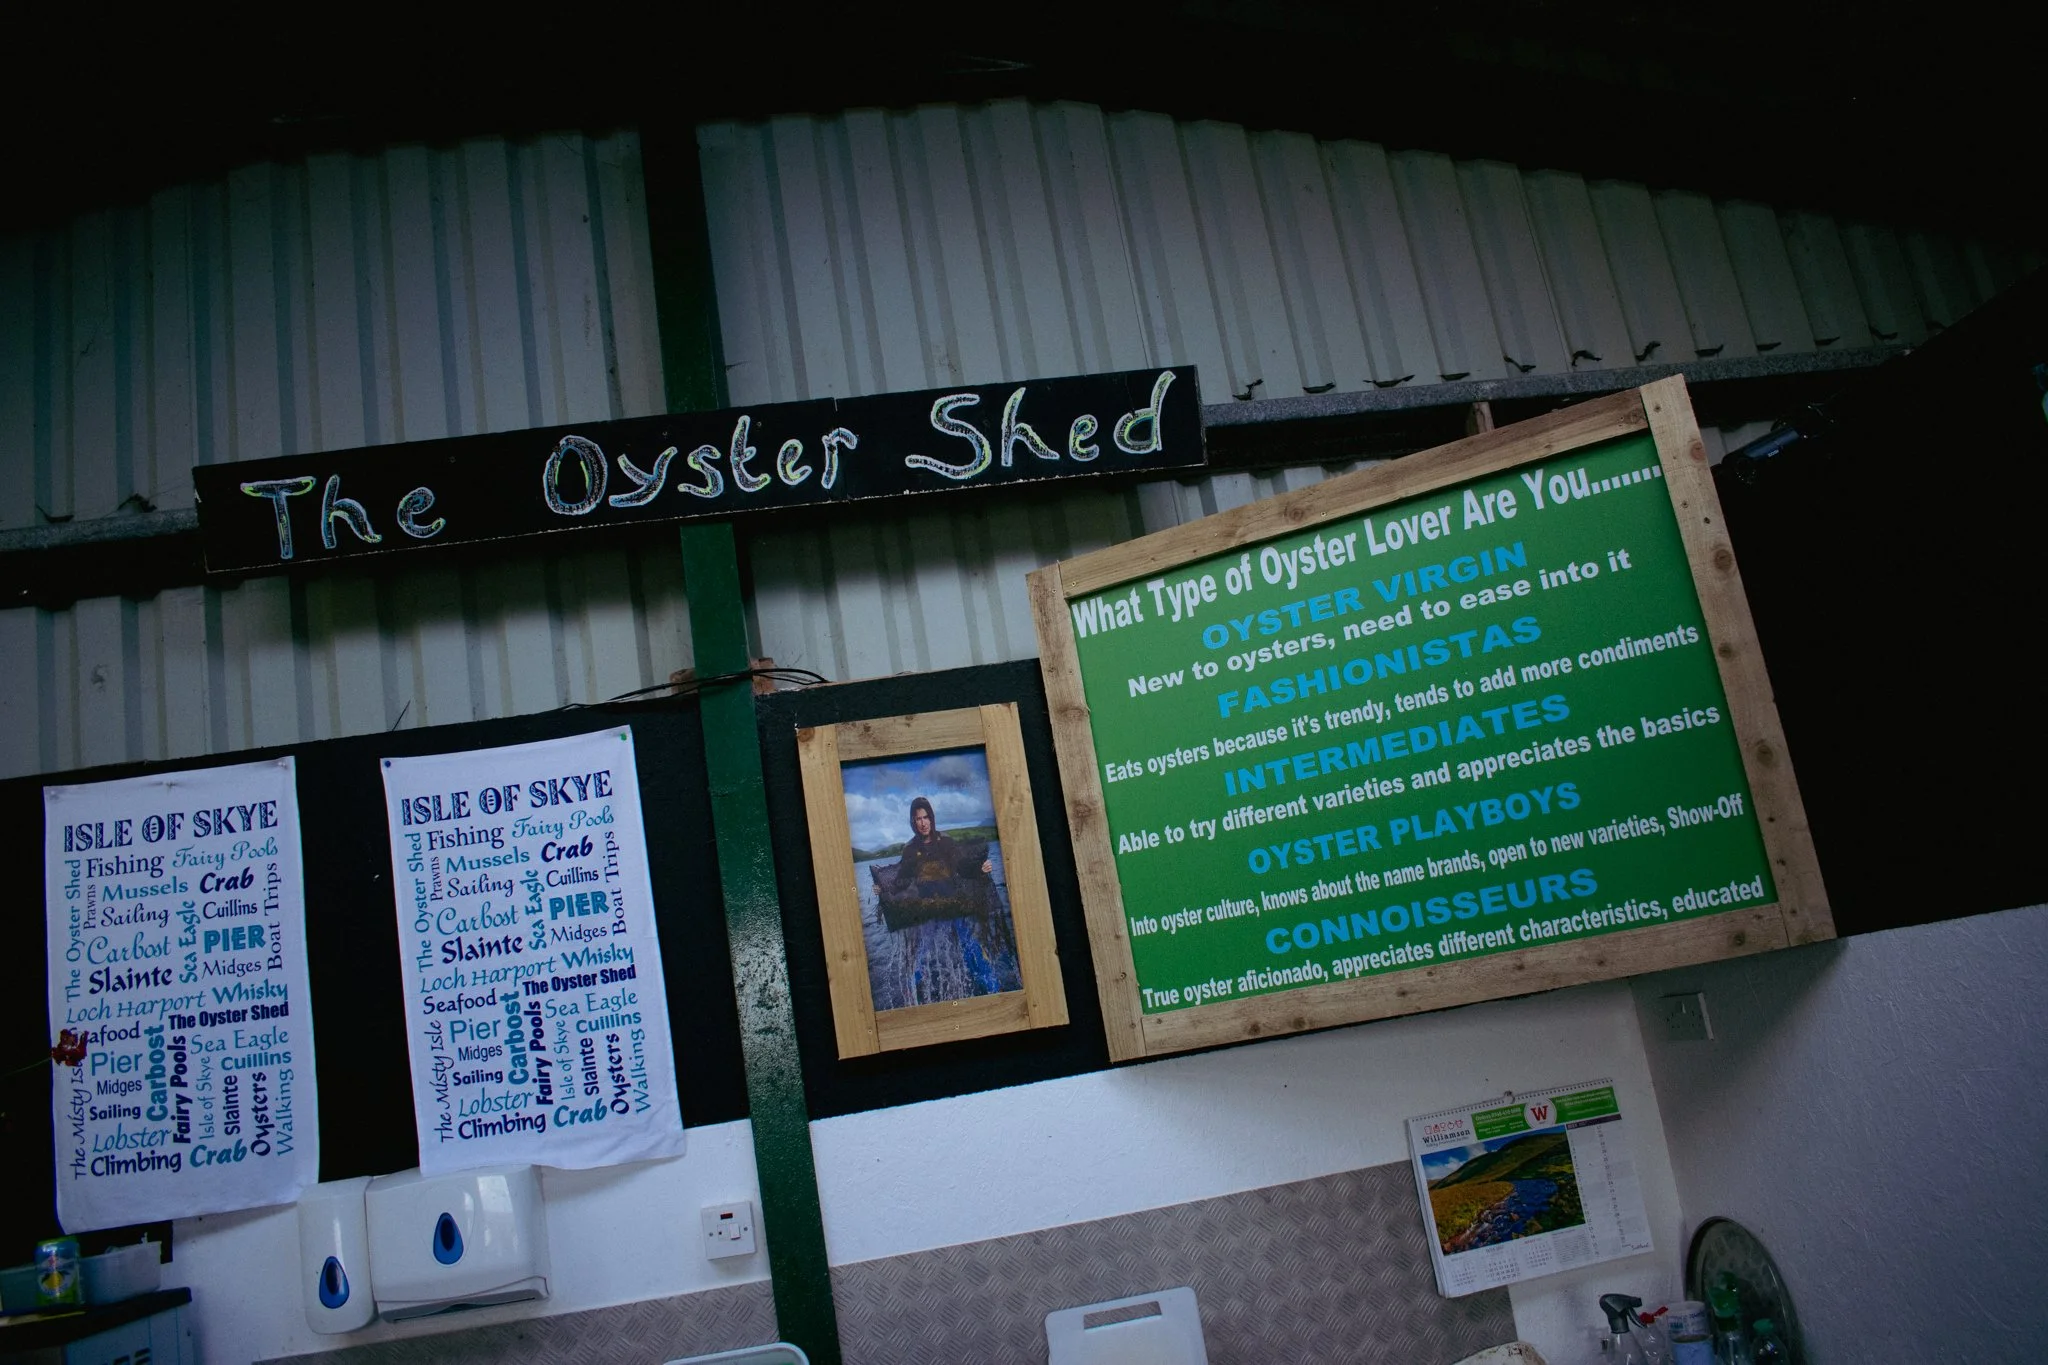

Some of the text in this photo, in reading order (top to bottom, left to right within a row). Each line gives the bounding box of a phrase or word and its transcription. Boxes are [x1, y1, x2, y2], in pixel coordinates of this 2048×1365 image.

[240, 371, 1177, 559] The Oyster Shed
[1071, 587, 1144, 638] What
[1147, 574, 1217, 622] Type
[1225, 552, 1251, 595] of
[1260, 530, 1357, 589] Oyster
[1363, 504, 1450, 556] Lover
[1463, 487, 1517, 530] Are
[1202, 541, 1528, 649] OYSTER VIRGIN
[1128, 549, 1632, 698] New to oysters, need to ease into it
[1217, 616, 1542, 718] FASHIONISTAS
[1105, 624, 1699, 783] Eats oysters because it's trendy, tends to add more condiments
[1224, 694, 1570, 797] INTERMEDIATES
[1118, 705, 1720, 854] Able to try different varieties and appreciates the basics
[401, 770, 613, 826] ISLE OF SKYE
[64, 800, 278, 853] ISLE OF SKYE
[426, 825, 505, 851] Fishing
[511, 805, 615, 840] Fairy Pools
[1248, 782, 1581, 874] OYSTER PLAYBOYS
[172, 836, 279, 870] Fairy Pools
[446, 846, 530, 874] Mussels
[541, 835, 594, 863] Crab
[1131, 792, 1744, 937] Into oyster culture, knows about the name brands, open to new varieties, Show-Off
[86, 854, 165, 878] Fishing
[200, 866, 254, 894] Crab
[430, 856, 443, 902] Prawns
[546, 867, 599, 888] Cuillins
[103, 876, 189, 902] Mussels
[447, 874, 515, 898] Sailing
[603, 830, 627, 936] Boat Trips
[101, 903, 169, 928] Sailing
[203, 899, 258, 919] Cuillins
[264, 862, 282, 971] Boat Trips
[404, 832, 434, 973] The Oyster Shed
[520, 869, 547, 951] Sea Eagle
[549, 890, 610, 921] PIER
[1266, 867, 1598, 955] CONNOISSEURS
[436, 901, 520, 936] Carbost
[87, 931, 171, 965] Carbost
[204, 924, 267, 954] PIER
[441, 935, 524, 964] Slainte
[550, 924, 608, 946] Midges
[1143, 874, 1764, 1009] True oyster aficionado, appreciates different characteristics, educated
[202, 958, 262, 979] Midges
[561, 943, 634, 970] Whisky
[89, 966, 172, 994] Slainte
[212, 978, 288, 1005] Whisky
[420, 959, 557, 994] Loch Harport
[523, 964, 636, 997] The Oyster Shed
[66, 991, 207, 1024] Loch Harport
[169, 1001, 289, 1030] The Oyster Shed
[423, 988, 497, 1015] Seafood
[545, 988, 639, 1019] Sea Eagle
[70, 1021, 141, 1047] afood
[424, 1020, 444, 1051] Isle
[450, 1019, 500, 1043] Pier
[500, 991, 529, 1085] Carbost
[576, 1012, 642, 1034] Cuillins
[191, 1025, 289, 1055] Sea Eagle
[458, 1044, 503, 1062] Midges
[524, 1001, 554, 1105] Fairy Pools
[91, 1051, 143, 1077] Pier
[144, 1024, 168, 1122] Carbost
[221, 1051, 292, 1071] Cuillins
[580, 1038, 599, 1097] Slainte
[606, 1033, 632, 1115] Oysters
[629, 1028, 652, 1114] Walking
[97, 1079, 142, 1097] Midges
[167, 1035, 193, 1144] Fairy Pools
[453, 1068, 503, 1086] Sailing
[89, 1105, 141, 1122] Sailing
[223, 1075, 241, 1136] Slainte
[251, 1071, 275, 1157] Oysters
[458, 1087, 535, 1118] Lobster
[553, 1098, 607, 1128] Crab
[92, 1123, 172, 1153] Lobster
[434, 1109, 453, 1143] The
[458, 1112, 546, 1140] Climbing
[1422, 1128, 1471, 1144] Williamson
[90, 1152, 181, 1178] Climbing
[190, 1139, 248, 1168] Crab
